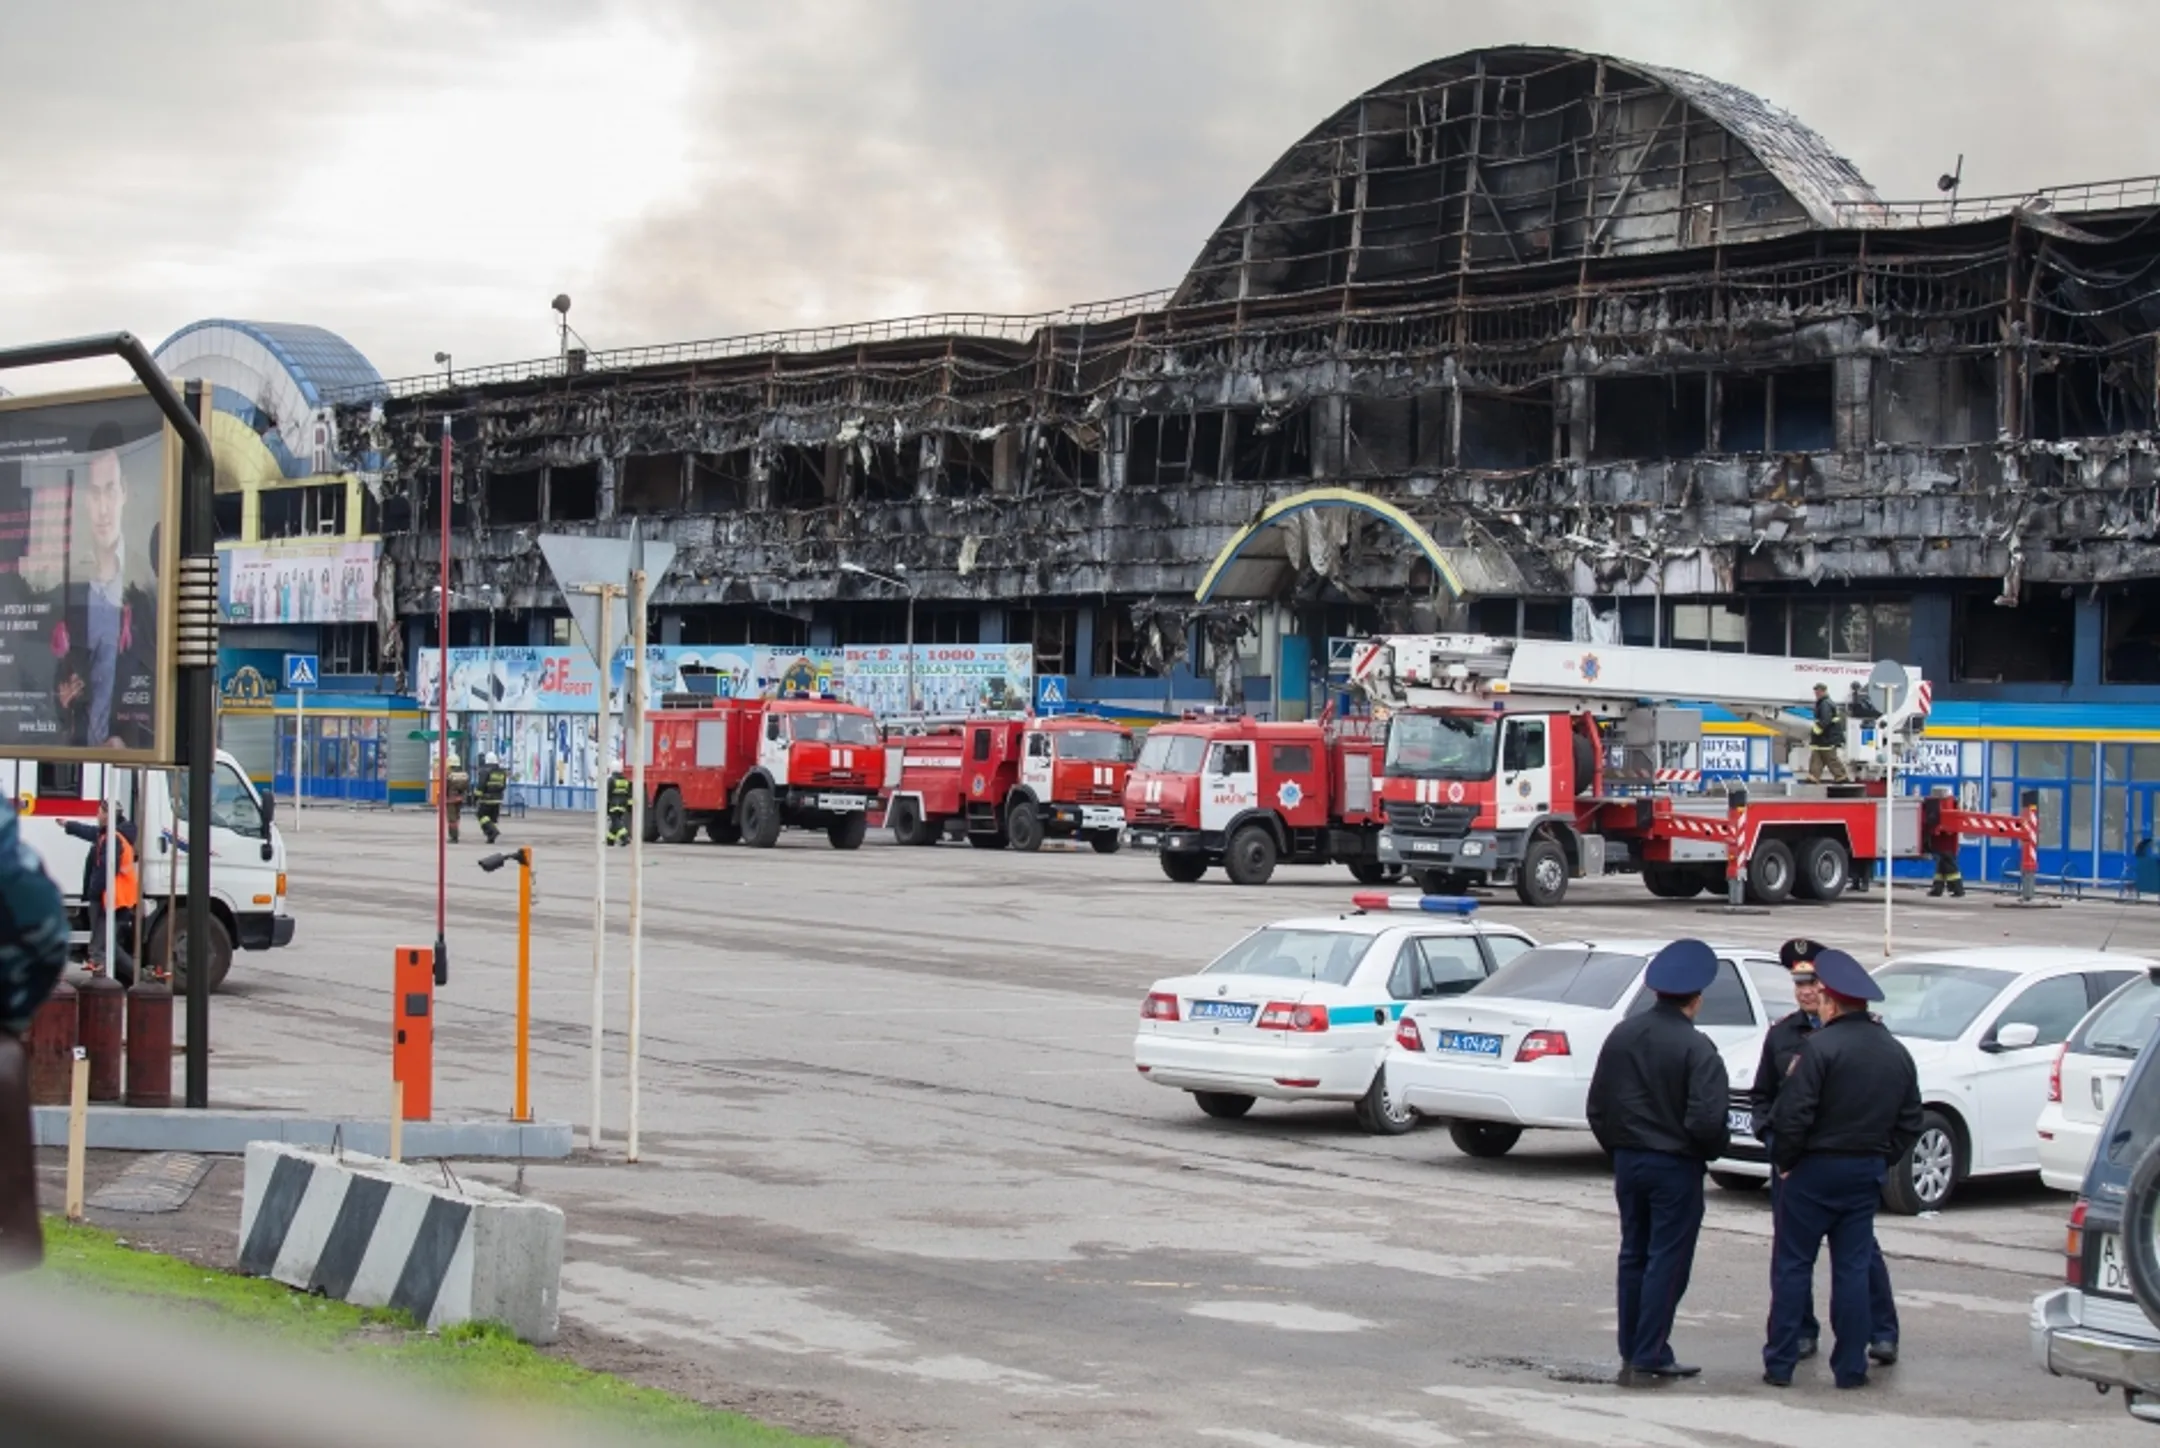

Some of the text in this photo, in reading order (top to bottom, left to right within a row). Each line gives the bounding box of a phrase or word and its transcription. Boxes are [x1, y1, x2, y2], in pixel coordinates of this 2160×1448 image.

[927, 650, 976, 661] 1000
[542, 657, 571, 692] GF
[563, 682, 593, 696] SPORT
[1702, 739, 1746, 752] ШУБЫ
[1705, 757, 1743, 769] МЕХА
